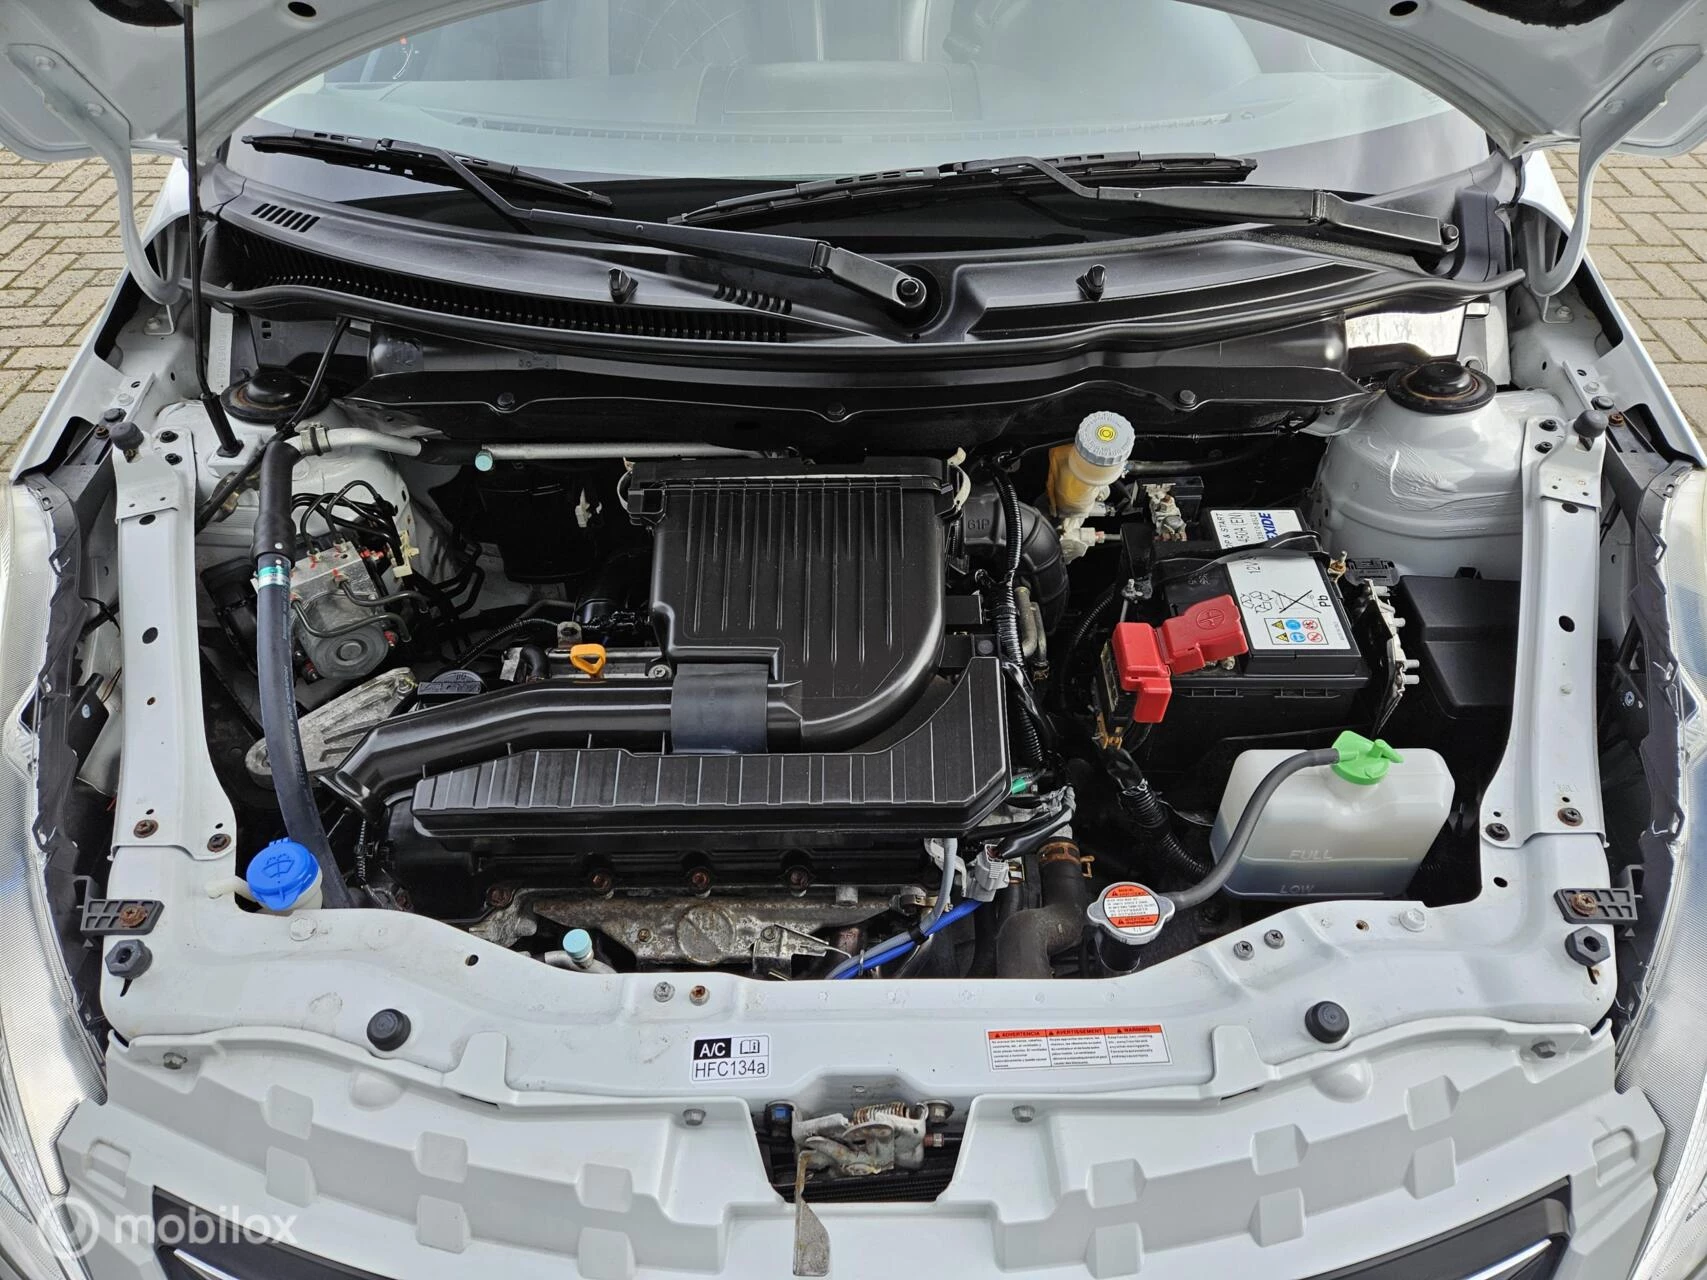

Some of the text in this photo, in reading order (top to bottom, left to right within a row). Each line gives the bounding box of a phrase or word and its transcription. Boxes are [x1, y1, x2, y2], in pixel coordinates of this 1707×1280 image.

[1216, 512, 1229, 532] START
[1259, 512, 1278, 541] EXIDE
[1319, 595, 1331, 607] Pb
[1289, 849, 1333, 860] FULL
[1280, 884, 1316, 894] LOW
[700, 1042, 726, 1057] A/C
[695, 1059, 765, 1078] HFC134a
